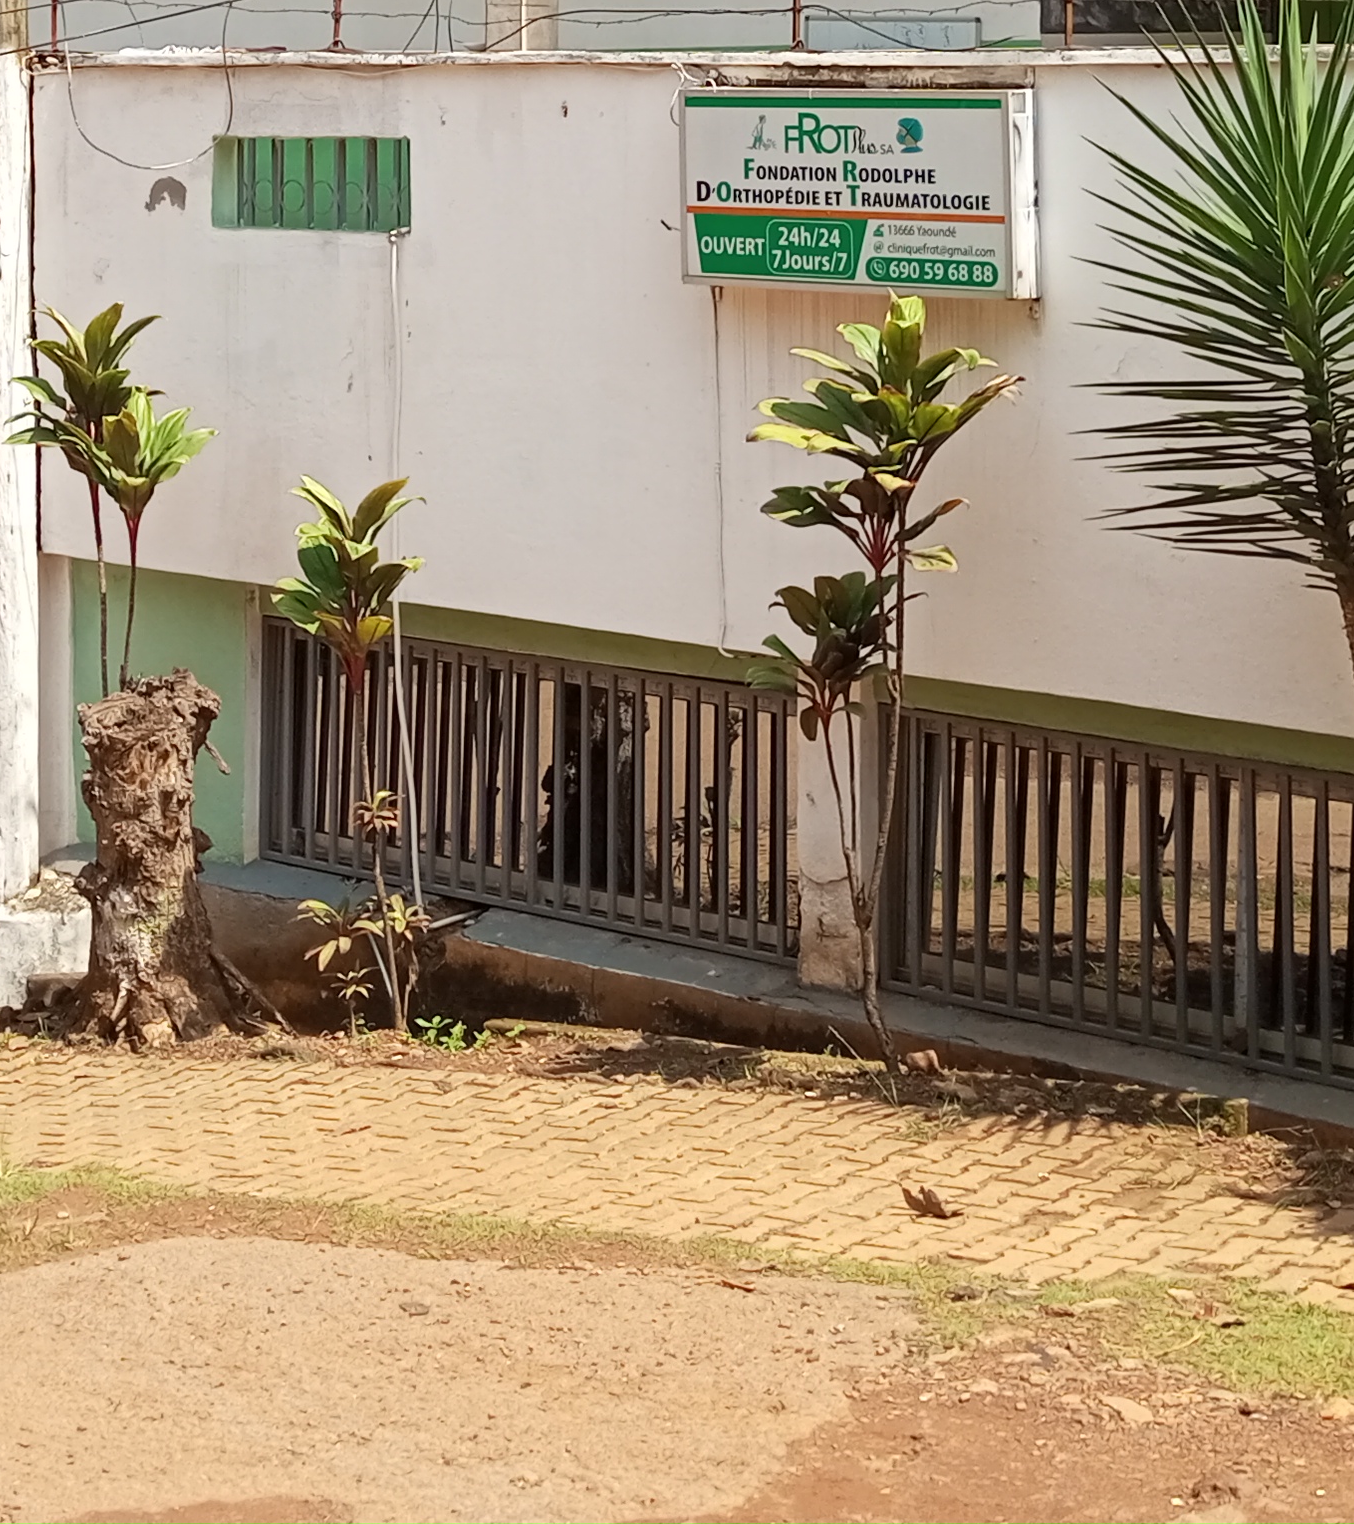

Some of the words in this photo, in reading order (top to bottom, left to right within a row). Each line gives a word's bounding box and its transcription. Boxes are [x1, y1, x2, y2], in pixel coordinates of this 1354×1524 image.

[880, 144, 894, 155] SA
[743, 158, 837, 182] FONDATION
[842, 160, 936, 184] RODOLPHE
[696, 180, 820, 206] D'ORTHOPÉDIE
[825, 191, 843, 206] ET
[846, 184, 990, 211] TRAUMATOLOGIE
[778, 225, 841, 248] 24h/24
[887, 224, 915, 236] 13666
[917, 224, 957, 238] Yaoundé
[700, 236, 765, 256] OUVERT
[887, 242, 996, 258] cliniquefrot@gmail.com
[771, 249, 848, 273] 7Jours/7
[889, 261, 920, 279] 690
[924, 262, 944, 280] 59
[948, 263, 969, 281] 68
[972, 264, 994, 283] 88
